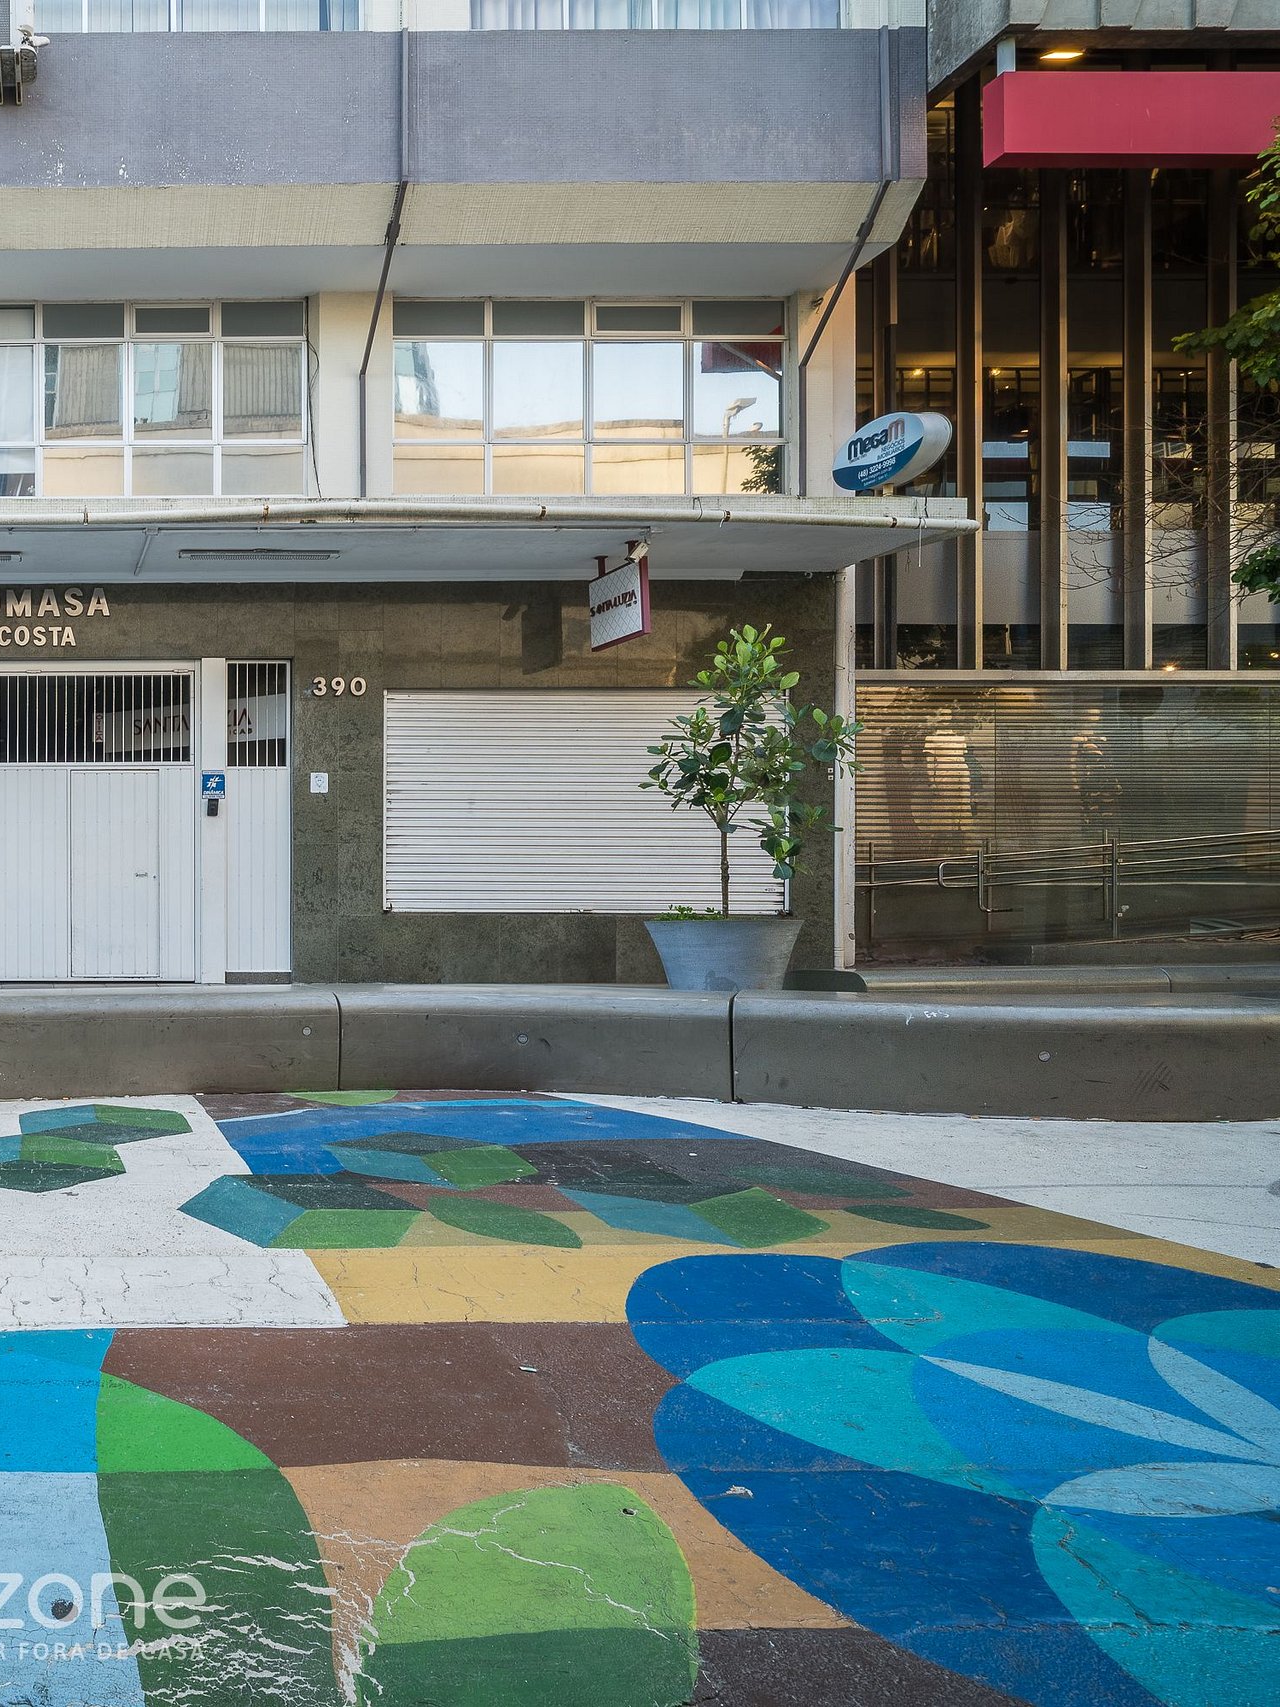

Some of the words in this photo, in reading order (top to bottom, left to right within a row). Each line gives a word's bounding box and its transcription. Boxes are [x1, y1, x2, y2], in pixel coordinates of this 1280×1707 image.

[857, 468, 869, 480] (48)
[313, 676, 367, 696] 390
[133, 714, 190, 736] SANTA
